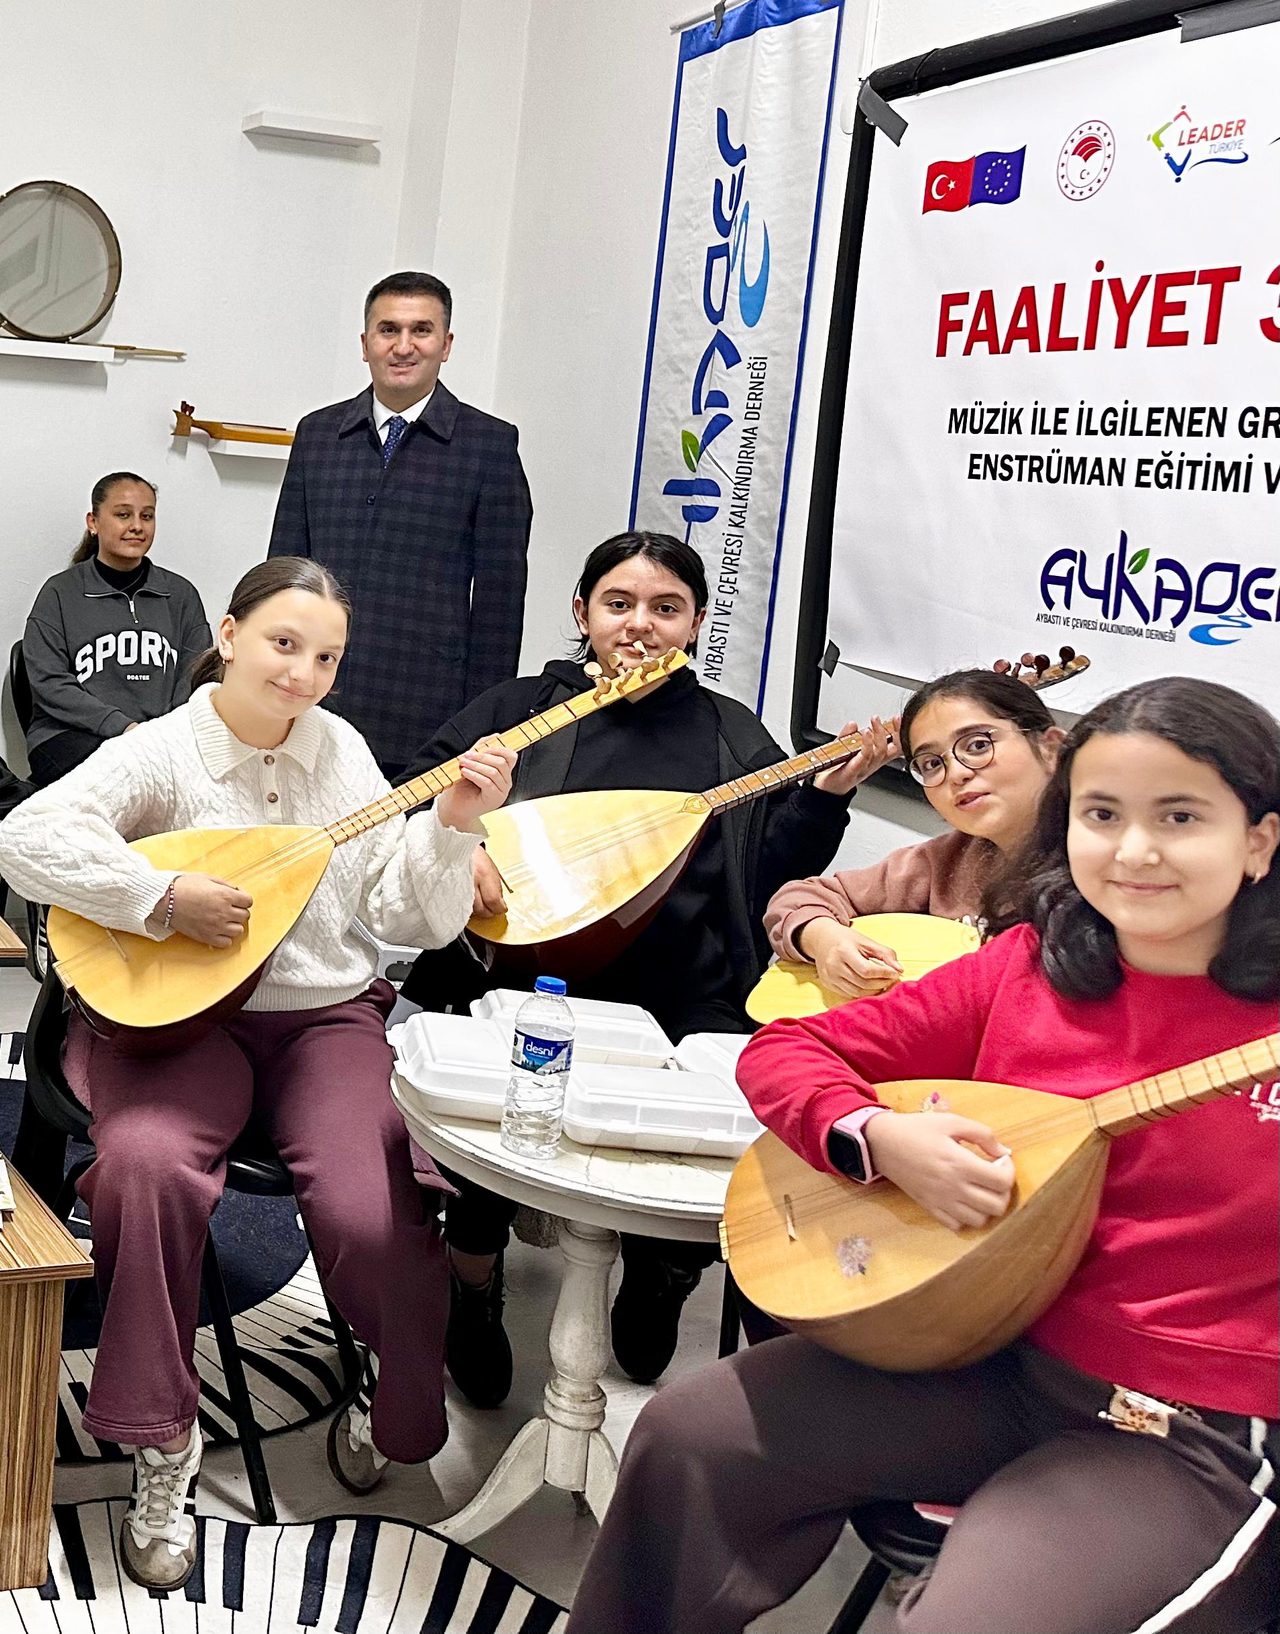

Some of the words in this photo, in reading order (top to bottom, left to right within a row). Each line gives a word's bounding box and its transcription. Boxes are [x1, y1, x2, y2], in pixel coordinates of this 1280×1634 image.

[1177, 119, 1246, 147] LEADER
[1209, 139, 1244, 155] TÜRKİYE
[936, 259, 1242, 358] FAALİYET
[744, 356, 768, 421] DERNEĞİ
[947, 400, 1024, 435] MÜZİK
[1030, 400, 1069, 435] İLE
[1076, 399, 1228, 438] İLGİLENEN
[728, 426, 759, 529] KALKINDIRMA
[968, 448, 1126, 487] ENSTRÜMAN
[1134, 450, 1254, 494] EĞİTİMİ
[717, 532, 744, 595] ÇEVRESİ
[1040, 529, 1280, 629] AYKADE
[713, 598, 733, 617] VE
[1035, 612, 1062, 627] AYBASTI
[1062, 615, 1071, 627] VE
[1071, 617, 1099, 631] ÇEVRESİ
[703, 621, 730, 682] AYBASTI
